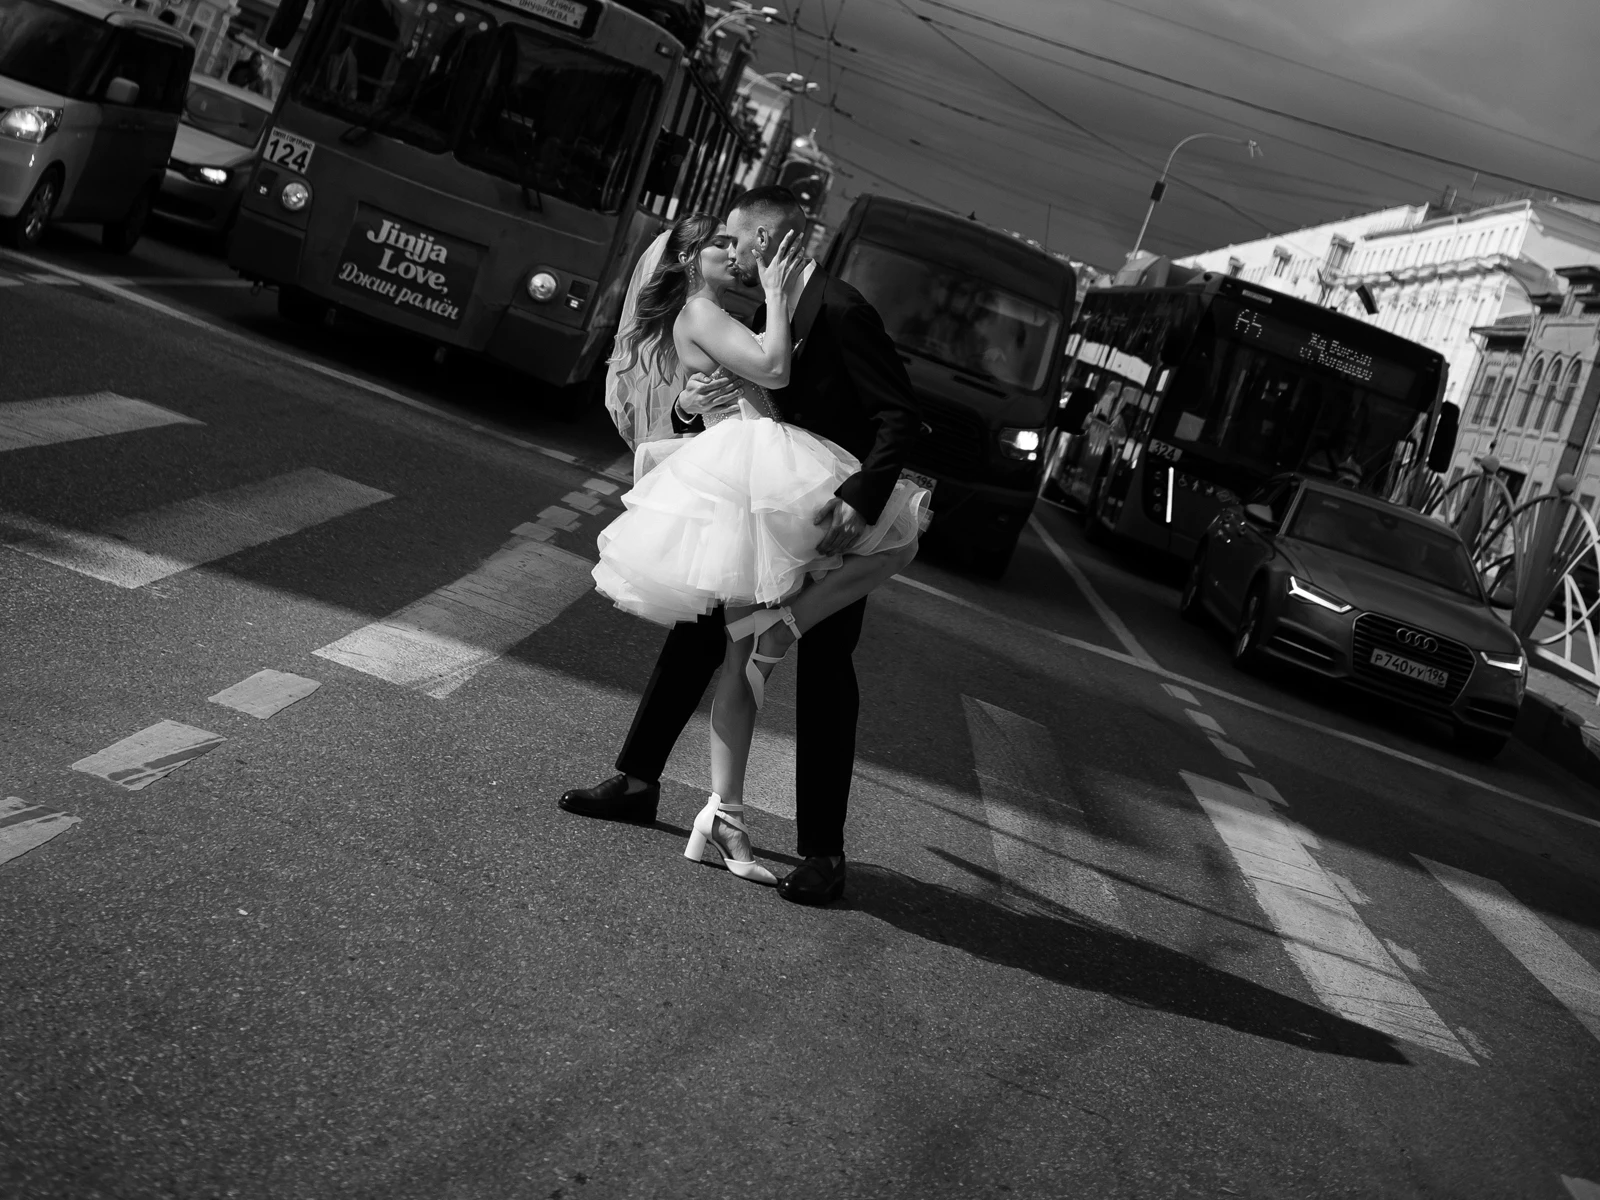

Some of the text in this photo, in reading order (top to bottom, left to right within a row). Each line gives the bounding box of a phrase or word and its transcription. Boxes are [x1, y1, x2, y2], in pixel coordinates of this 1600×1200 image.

[269, 139, 308, 171] 124
[366, 219, 448, 264] Jinjja
[377, 248, 449, 294] Love,
[338, 261, 460, 320] Джин рамён
[1153, 442, 1176, 462] 324
[1426, 667, 1445, 682] 196
